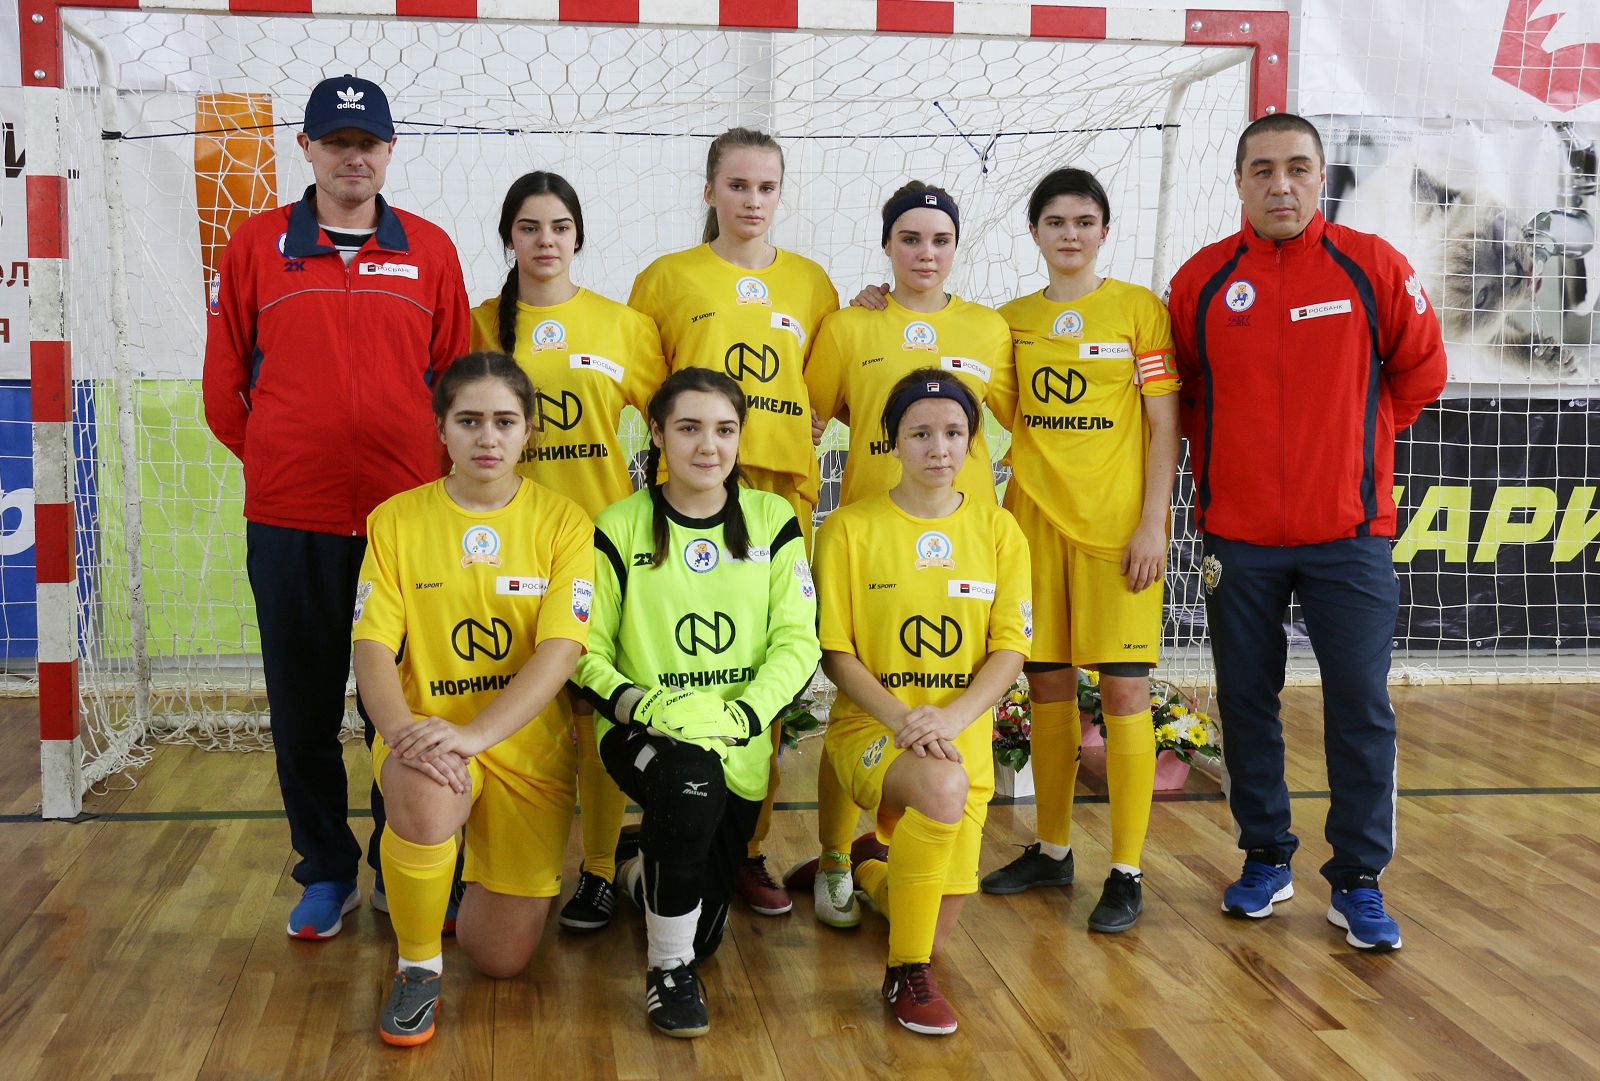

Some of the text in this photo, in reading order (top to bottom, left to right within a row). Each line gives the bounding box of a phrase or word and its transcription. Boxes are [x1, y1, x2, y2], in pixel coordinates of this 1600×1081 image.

[337, 102, 366, 110] adidas
[1308, 304, 1344, 315] РОСБАНК
[745, 394, 804, 417] ИКЕЛЬ
[665, 691, 695, 707] DEMIX
